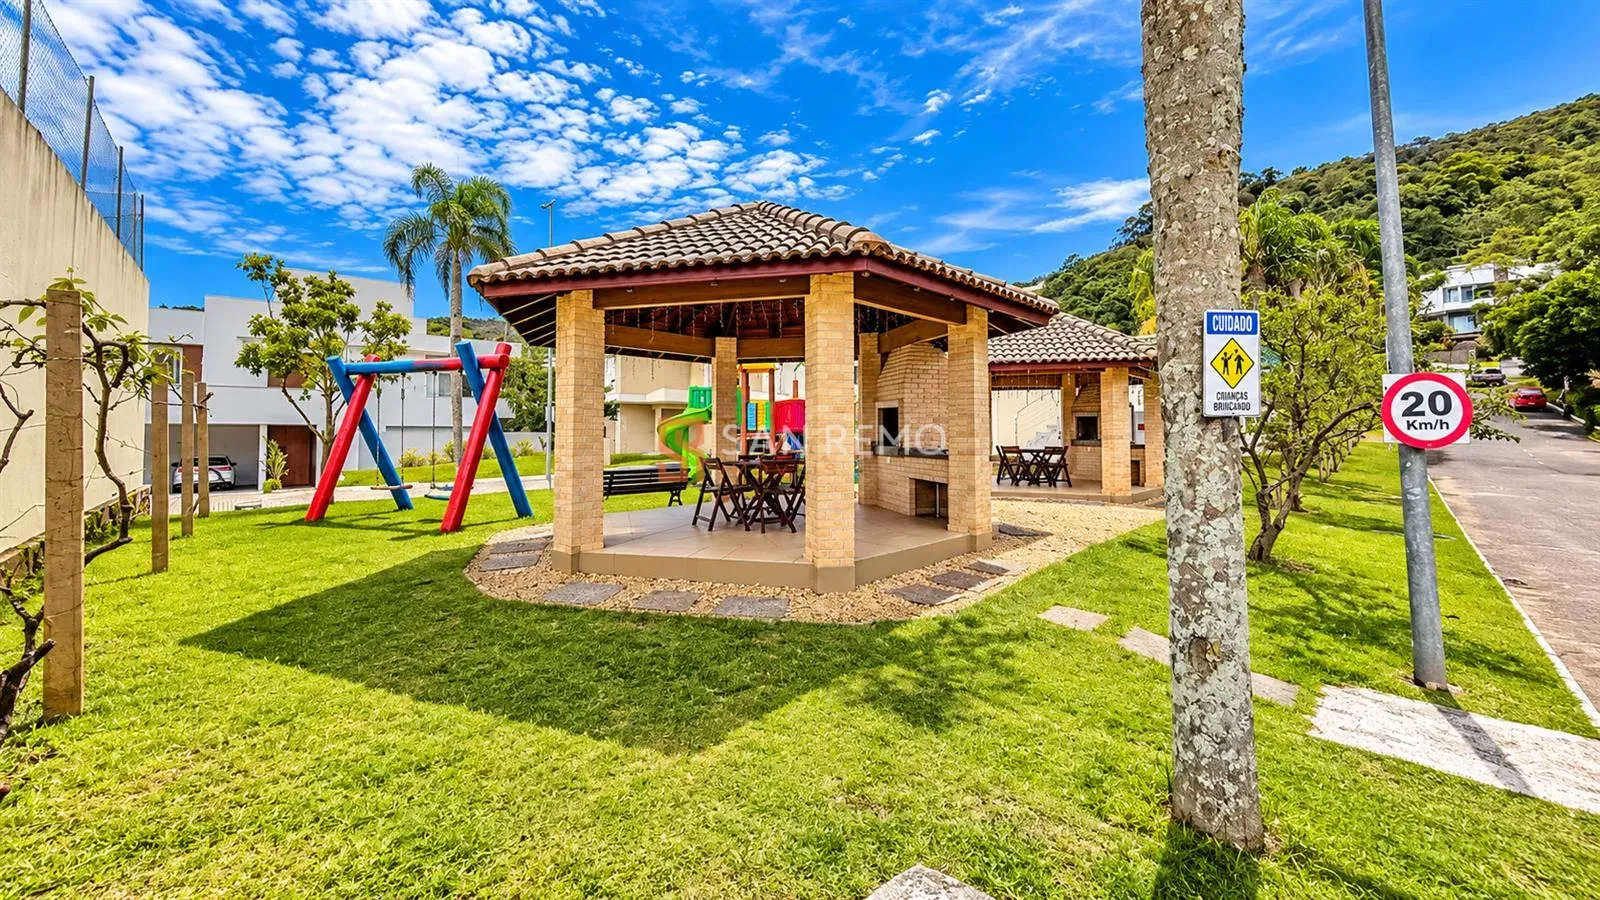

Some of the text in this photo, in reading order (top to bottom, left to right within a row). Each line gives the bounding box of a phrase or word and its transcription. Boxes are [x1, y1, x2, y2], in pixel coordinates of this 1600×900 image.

[1212, 315, 1252, 332] CUIDADO
[1216, 391, 1248, 402] CRIANÇAS
[1213, 402, 1251, 411] BRINCANDO
[1401, 390, 1452, 417] 20
[1406, 419, 1450, 431] Km/h
